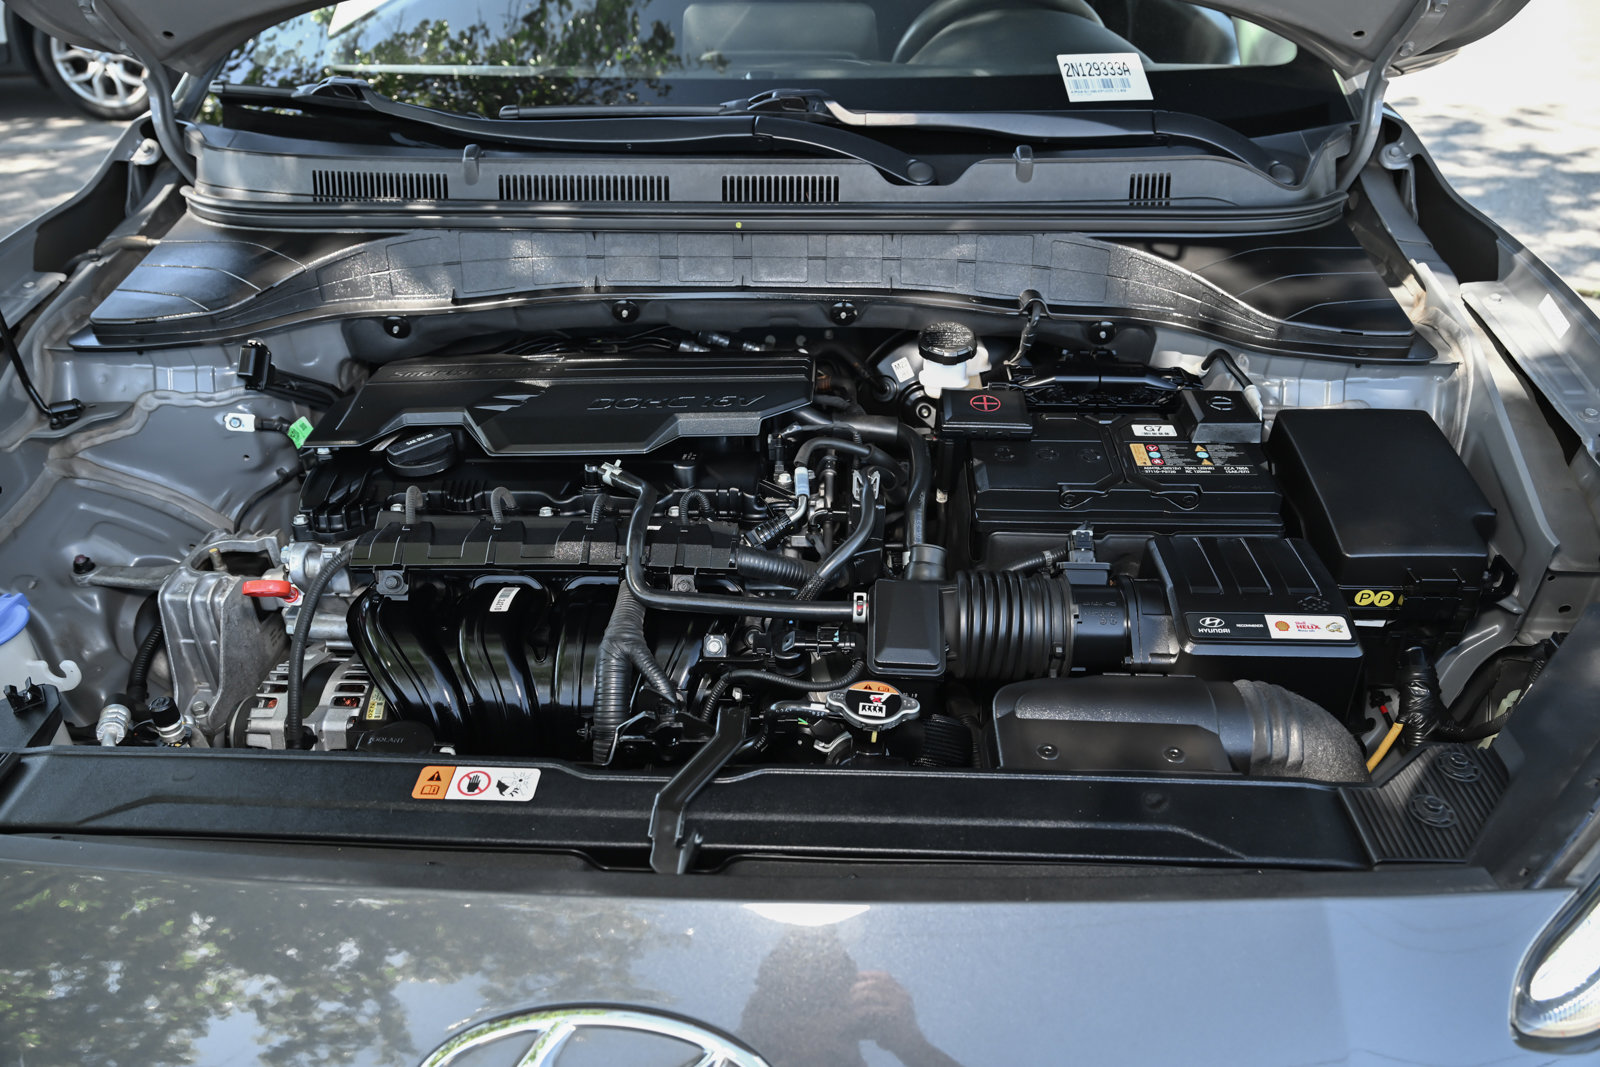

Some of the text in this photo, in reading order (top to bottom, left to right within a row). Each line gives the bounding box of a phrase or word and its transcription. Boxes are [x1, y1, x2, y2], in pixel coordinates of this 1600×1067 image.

[1063, 61, 1131, 77] 2N129333A
[586, 395, 696, 411] DOHC
[1359, 592, 1391, 604] P P
